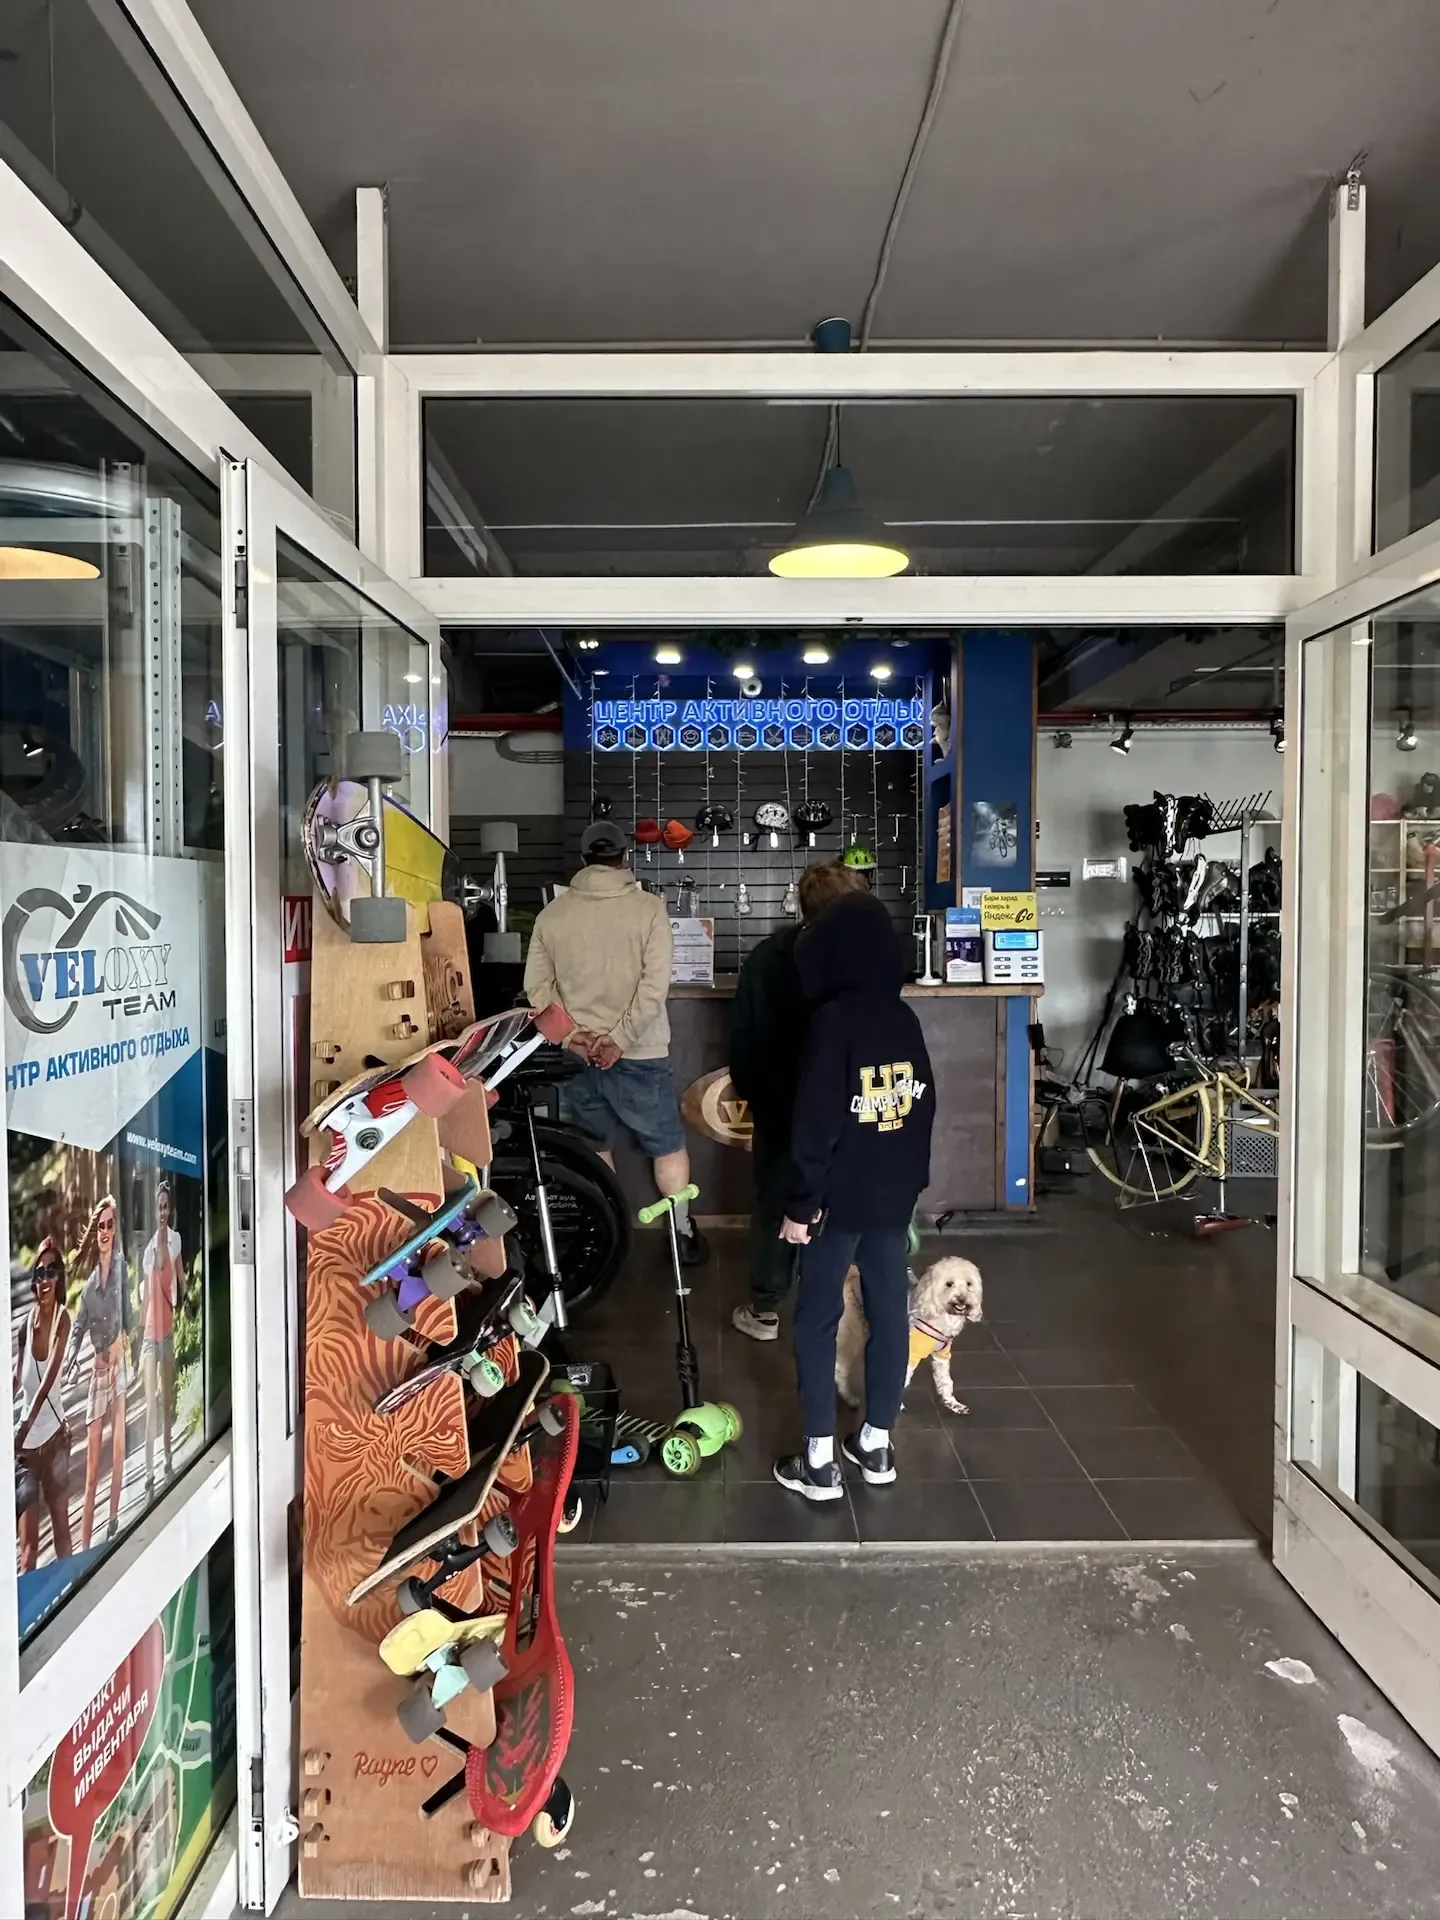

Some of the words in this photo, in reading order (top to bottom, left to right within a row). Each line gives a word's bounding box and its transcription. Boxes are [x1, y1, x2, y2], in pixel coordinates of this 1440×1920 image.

[595, 700, 677, 725] ЦЕНТР
[682, 700, 837, 723] АКТИВНОГО
[984, 911, 1015, 921] Яндекс
[1015, 908, 1034, 923] Go
[20, 944, 171, 1001] VELOXY
[103, 990, 176, 1020] TEAM
[46, 1038, 137, 1082] АКТИВНОГО
[141, 1027, 190, 1058] ОТДЫХА
[72, 1673, 117, 1745] ПУНКТ
[73, 1683, 131, 1777] ВЫДАЧИ
[75, 1688, 149, 1808] ИНВЕНТАРЯ
[353, 1750, 417, 1788] Rayne
